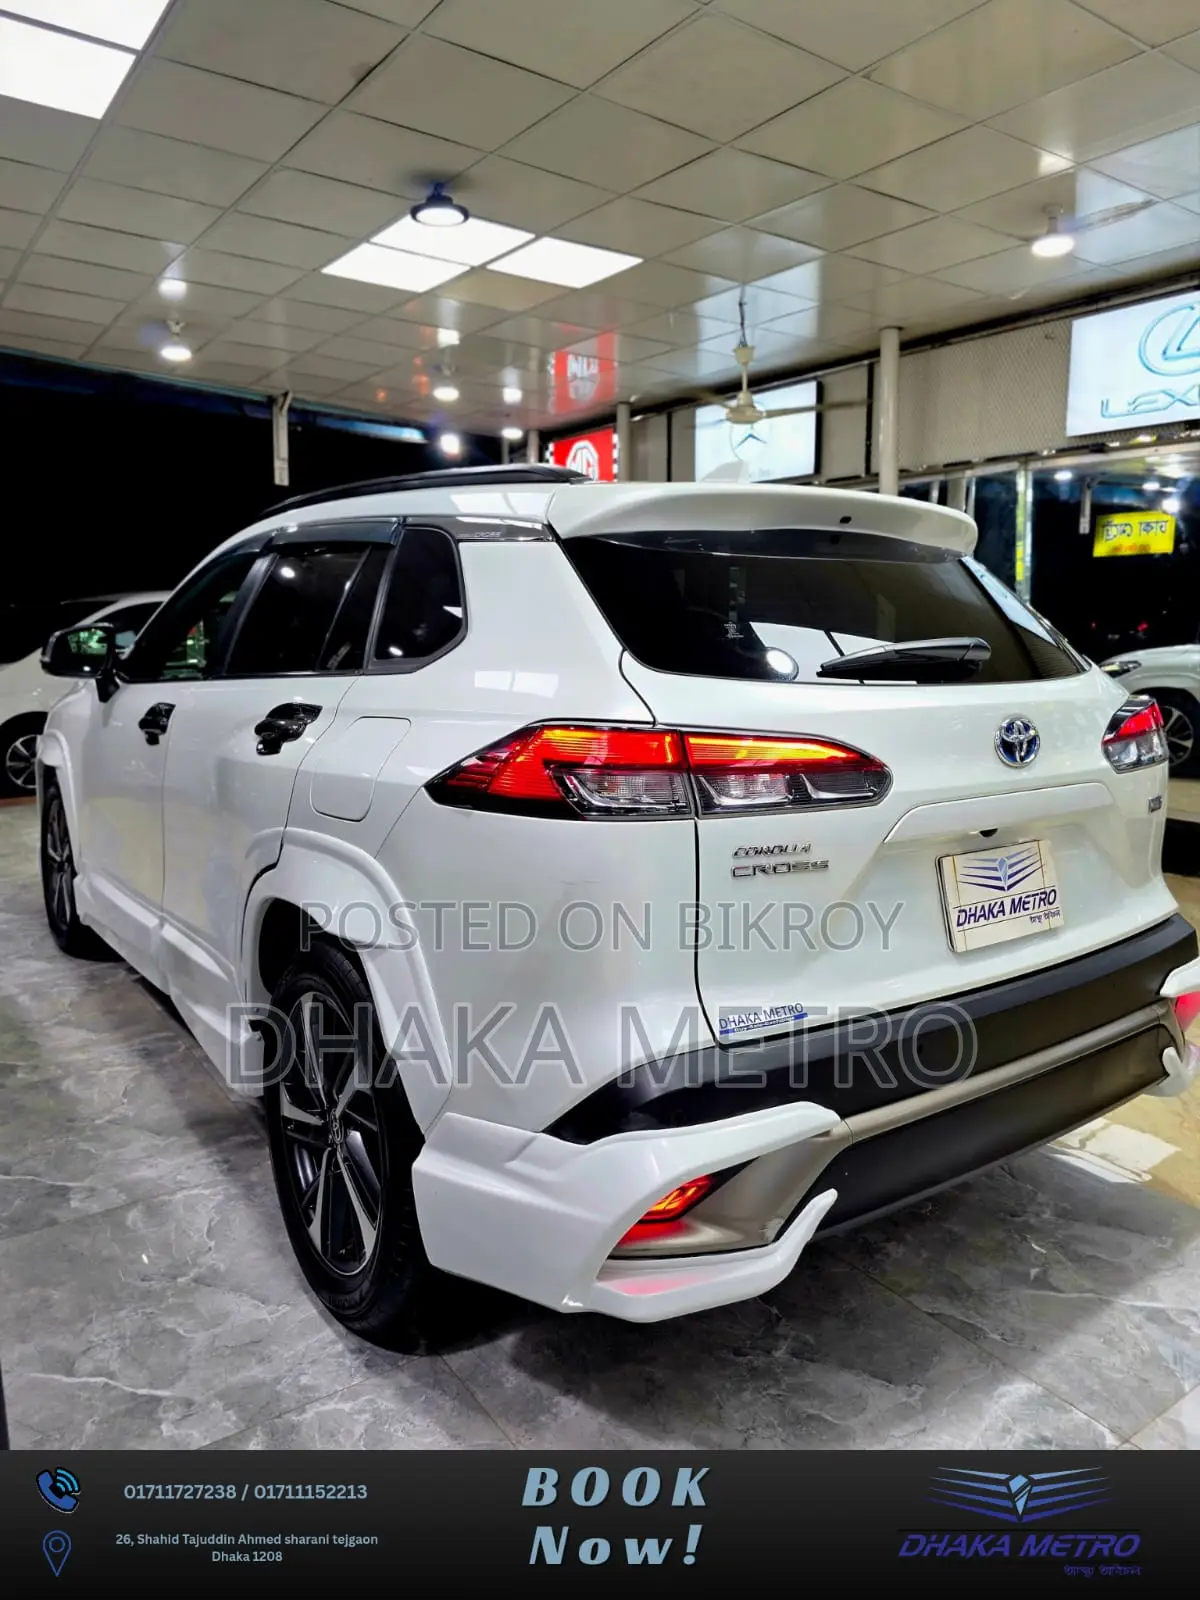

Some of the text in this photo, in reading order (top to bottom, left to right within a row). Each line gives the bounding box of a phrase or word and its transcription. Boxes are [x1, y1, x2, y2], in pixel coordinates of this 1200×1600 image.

[732, 860, 829, 878] CROSS
[956, 900, 1006, 927] DHAKA
[1009, 888, 1057, 915] METRO
[720, 1003, 804, 1029] DHAKA METRO
